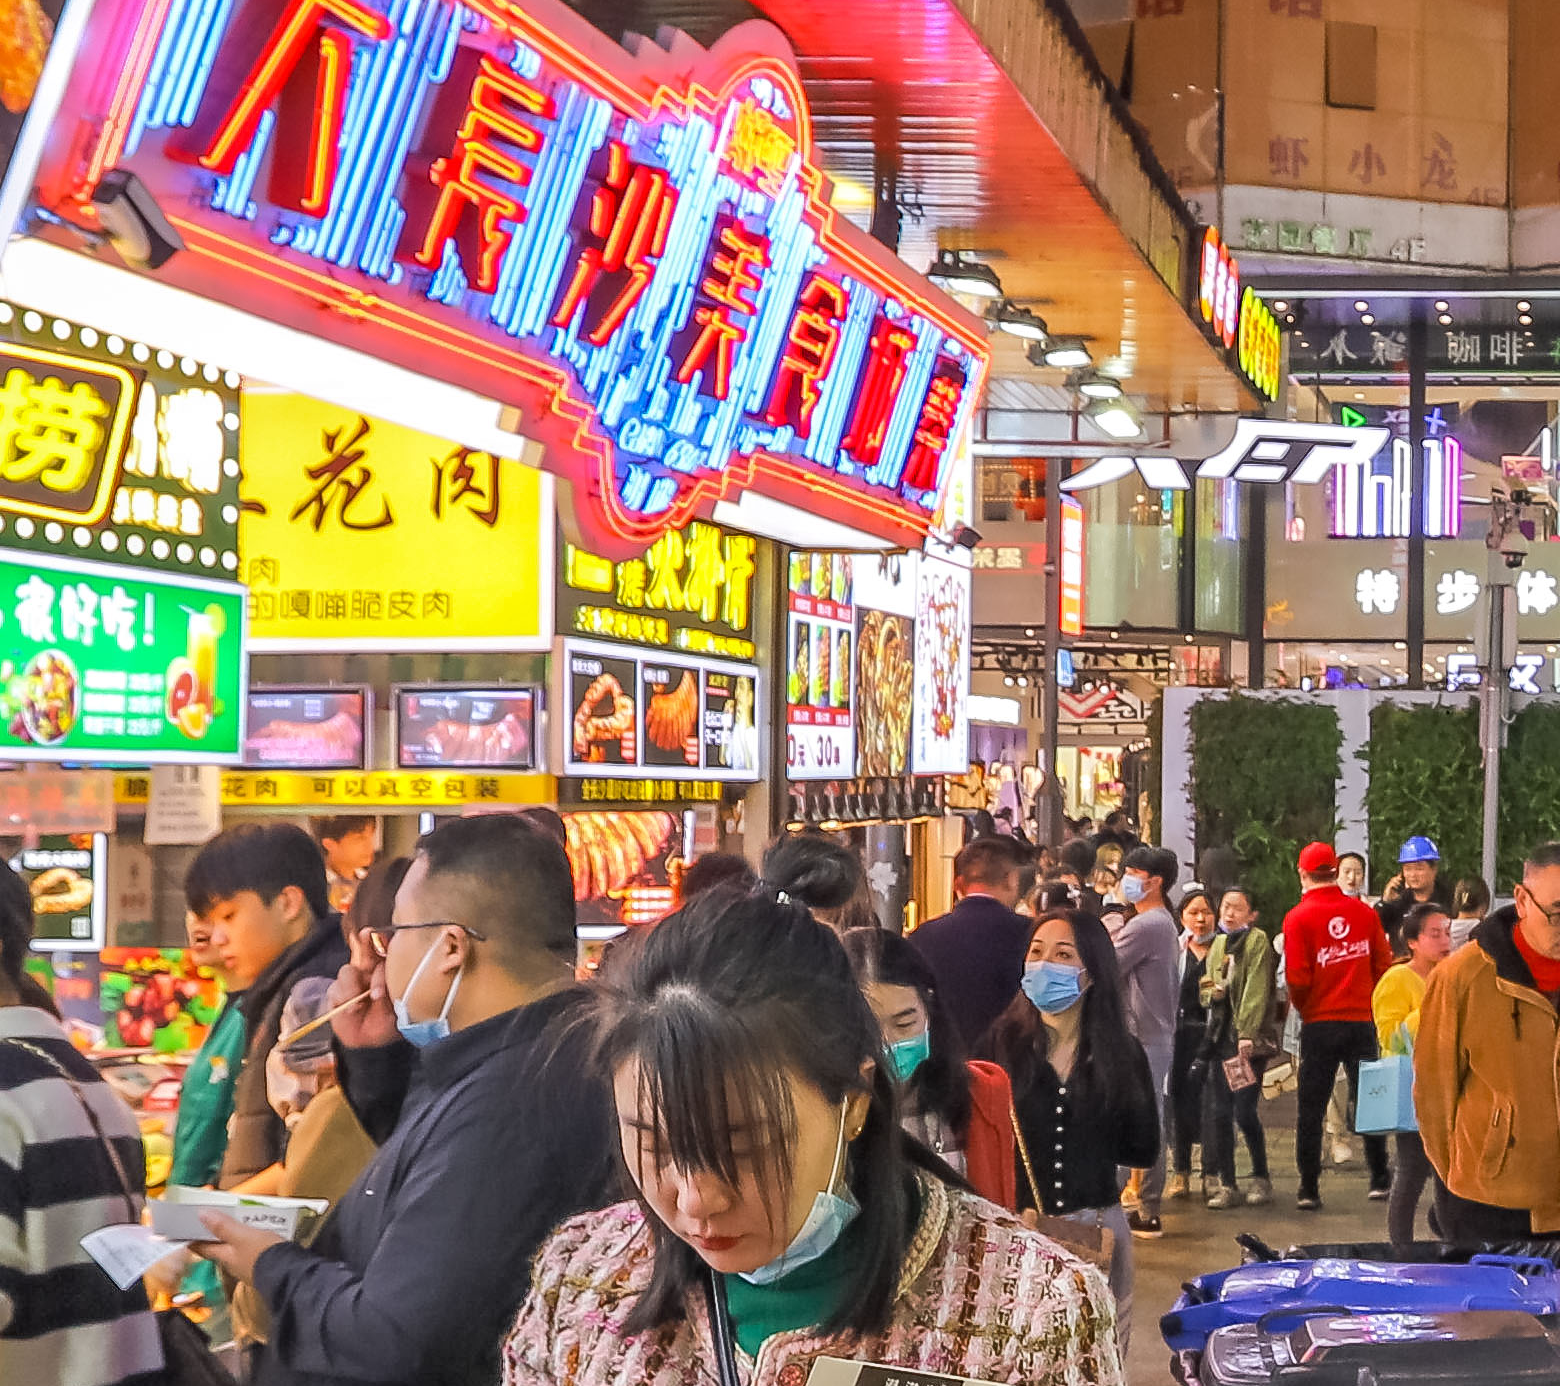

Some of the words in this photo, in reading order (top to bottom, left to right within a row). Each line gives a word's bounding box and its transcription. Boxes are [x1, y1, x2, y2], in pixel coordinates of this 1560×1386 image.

[1446, 330, 1525, 365] 咖啡
[241, 415, 501, 533] 花肉
[310, 774, 503, 801] 可以真空包装
